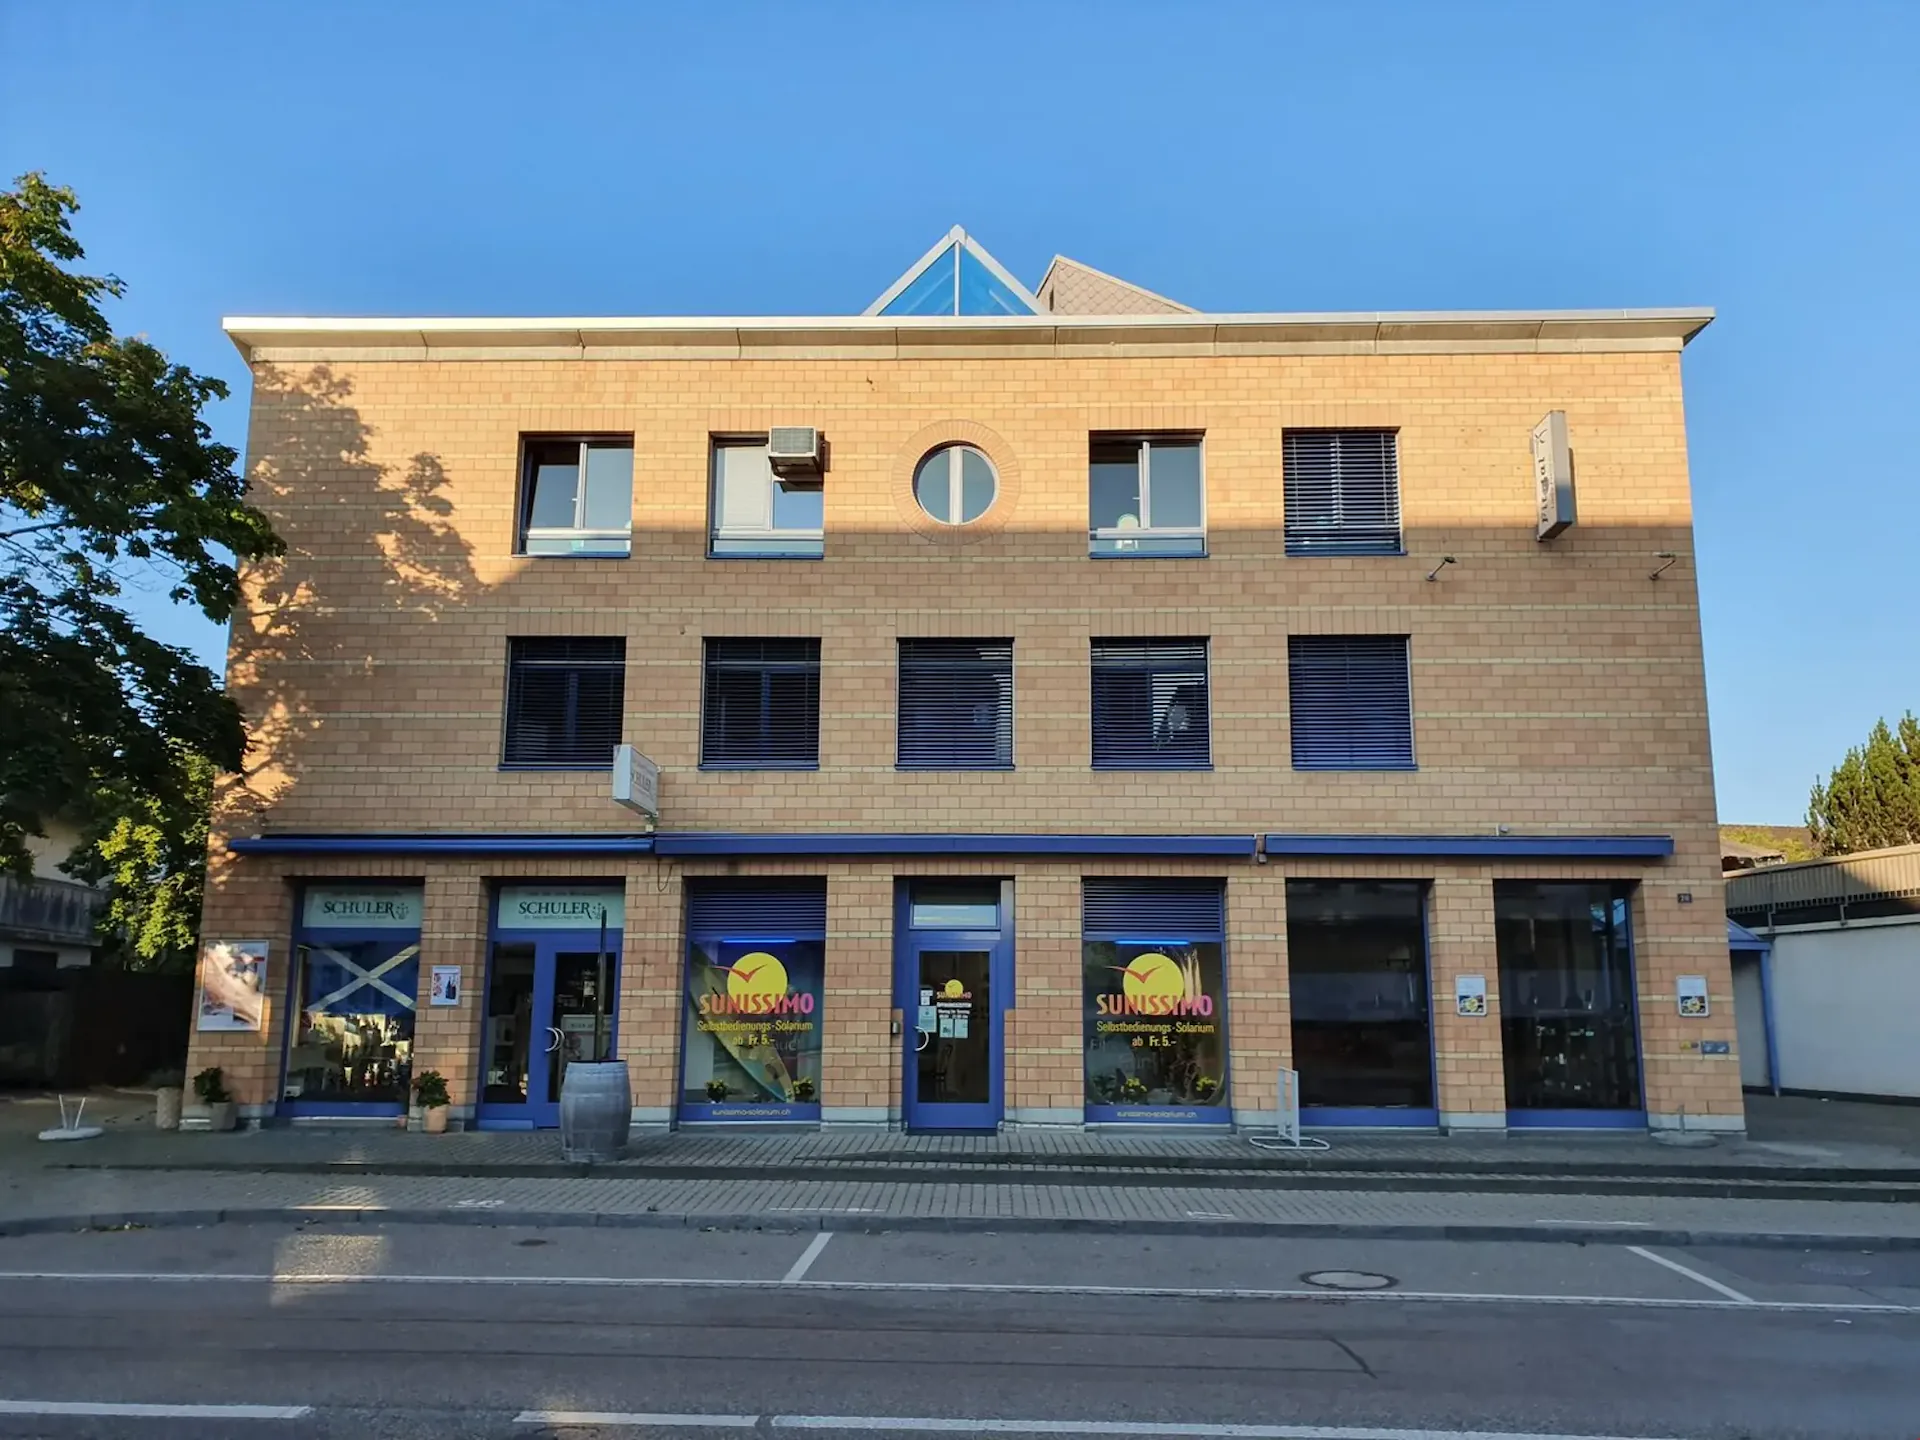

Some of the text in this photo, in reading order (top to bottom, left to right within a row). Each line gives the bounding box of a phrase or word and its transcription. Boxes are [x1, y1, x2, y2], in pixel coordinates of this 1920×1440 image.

[323, 901, 396, 920] SCHULER
[518, 901, 592, 920] SCHULER
[698, 992, 815, 1015] SUNISSIMO
[1096, 993, 1213, 1016] SUNISSIMO
[732, 1035, 744, 1046] ab
[1131, 1035, 1144, 1047] ab
